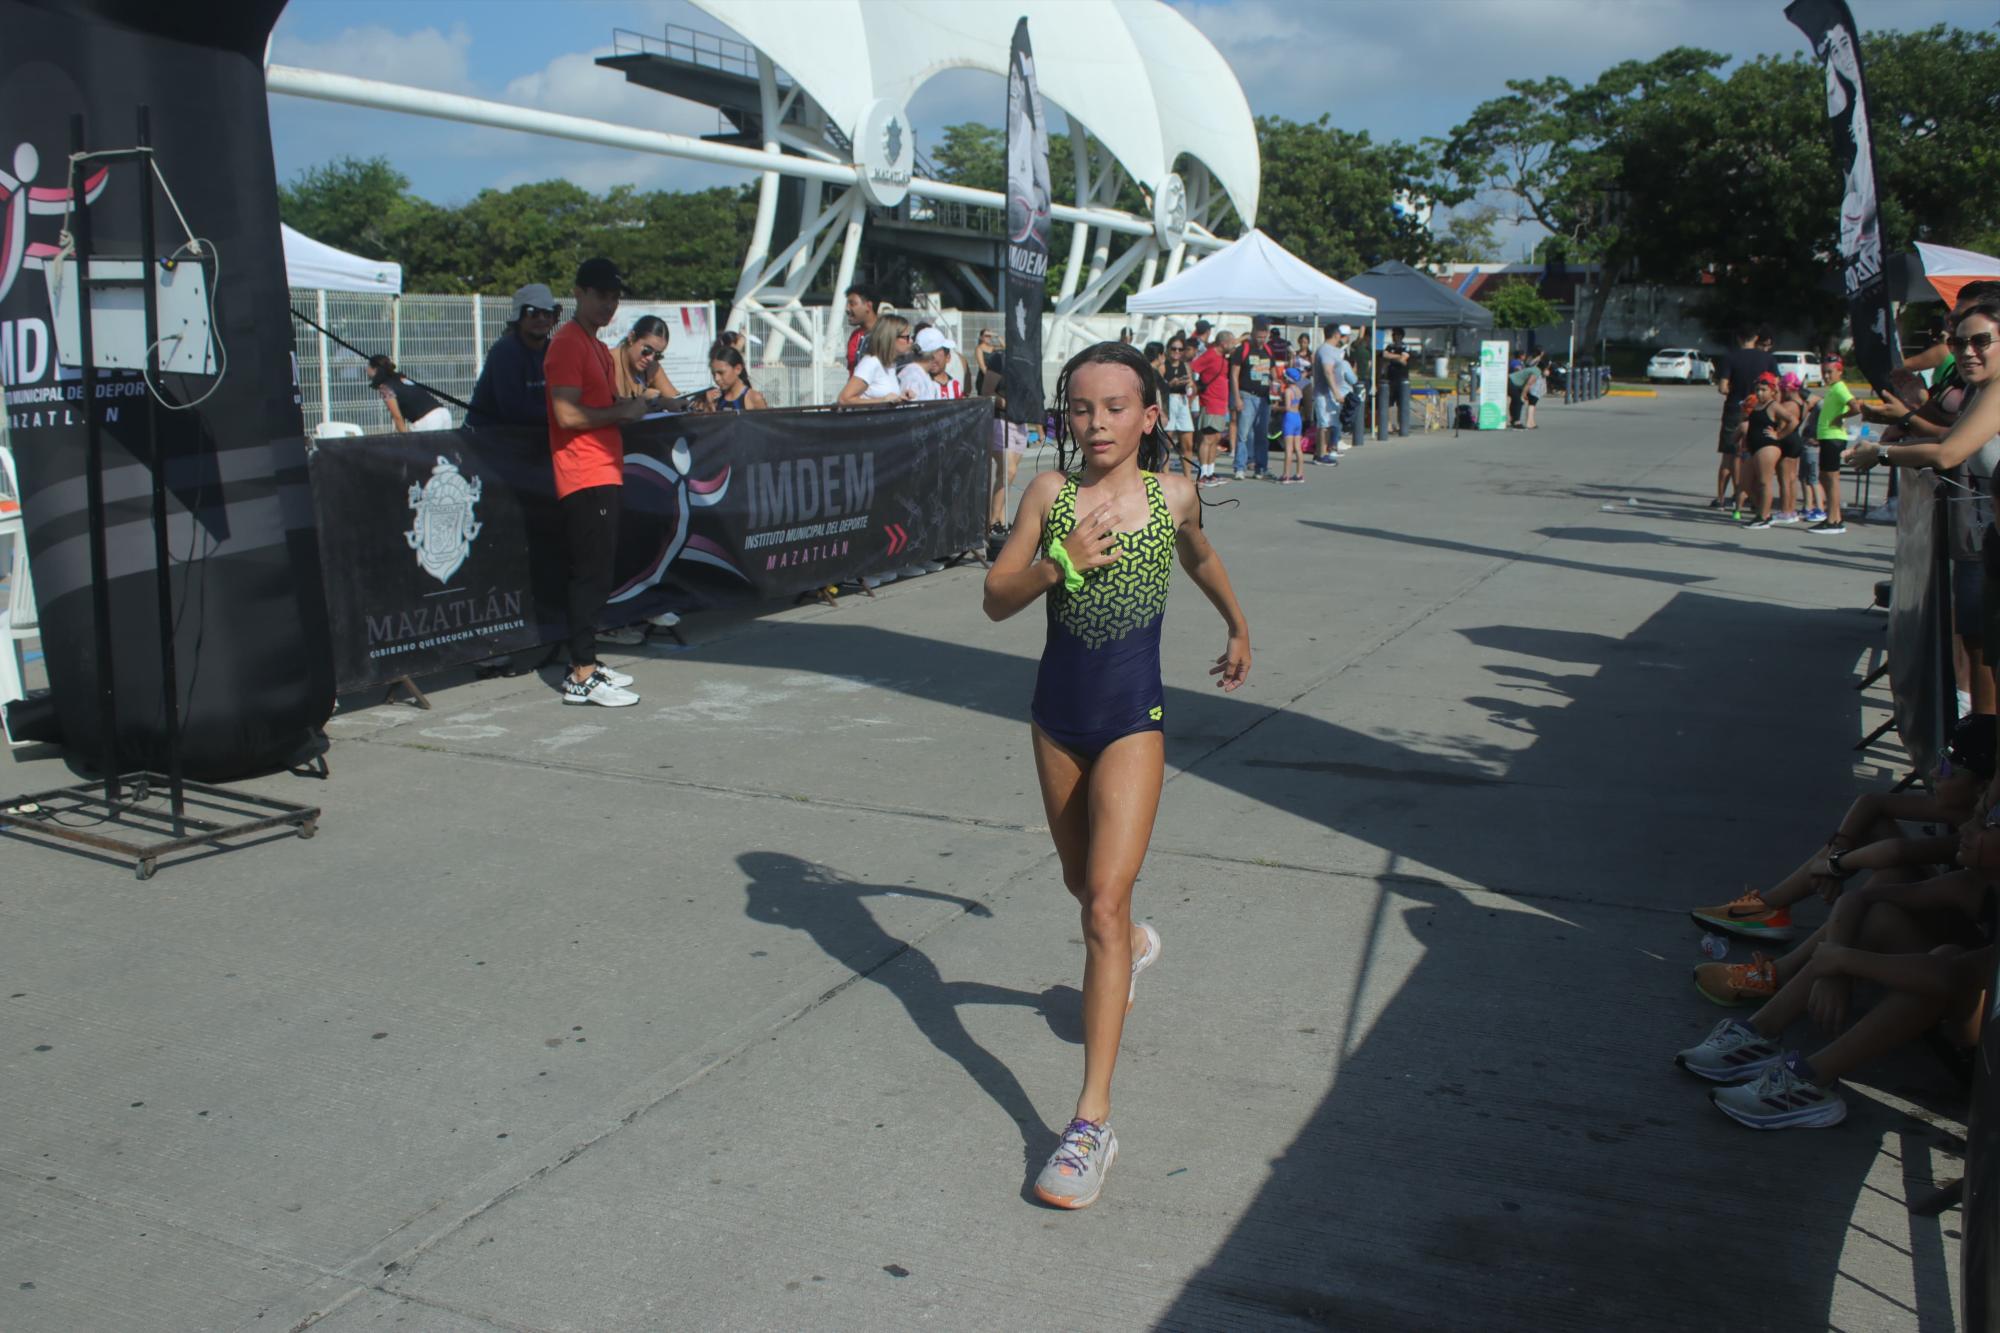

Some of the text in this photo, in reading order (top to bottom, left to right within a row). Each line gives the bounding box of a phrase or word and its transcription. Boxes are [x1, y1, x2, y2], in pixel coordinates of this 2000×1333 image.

[1008, 244, 1048, 277] IMDEM
[746, 451, 875, 530] IMDEM
[744, 514, 869, 550] INSTITUTO MUNICIPAL DEL DEPORTE
[766, 538, 849, 571] MAZATLÁN
[365, 586, 523, 645] MAZATLÁN
[369, 642, 416, 659] GOBIERNO
[418, 638, 436, 650] QUE
[435, 630, 474, 645] ESCUCHA
[482, 619, 525, 635] RESUELVE
